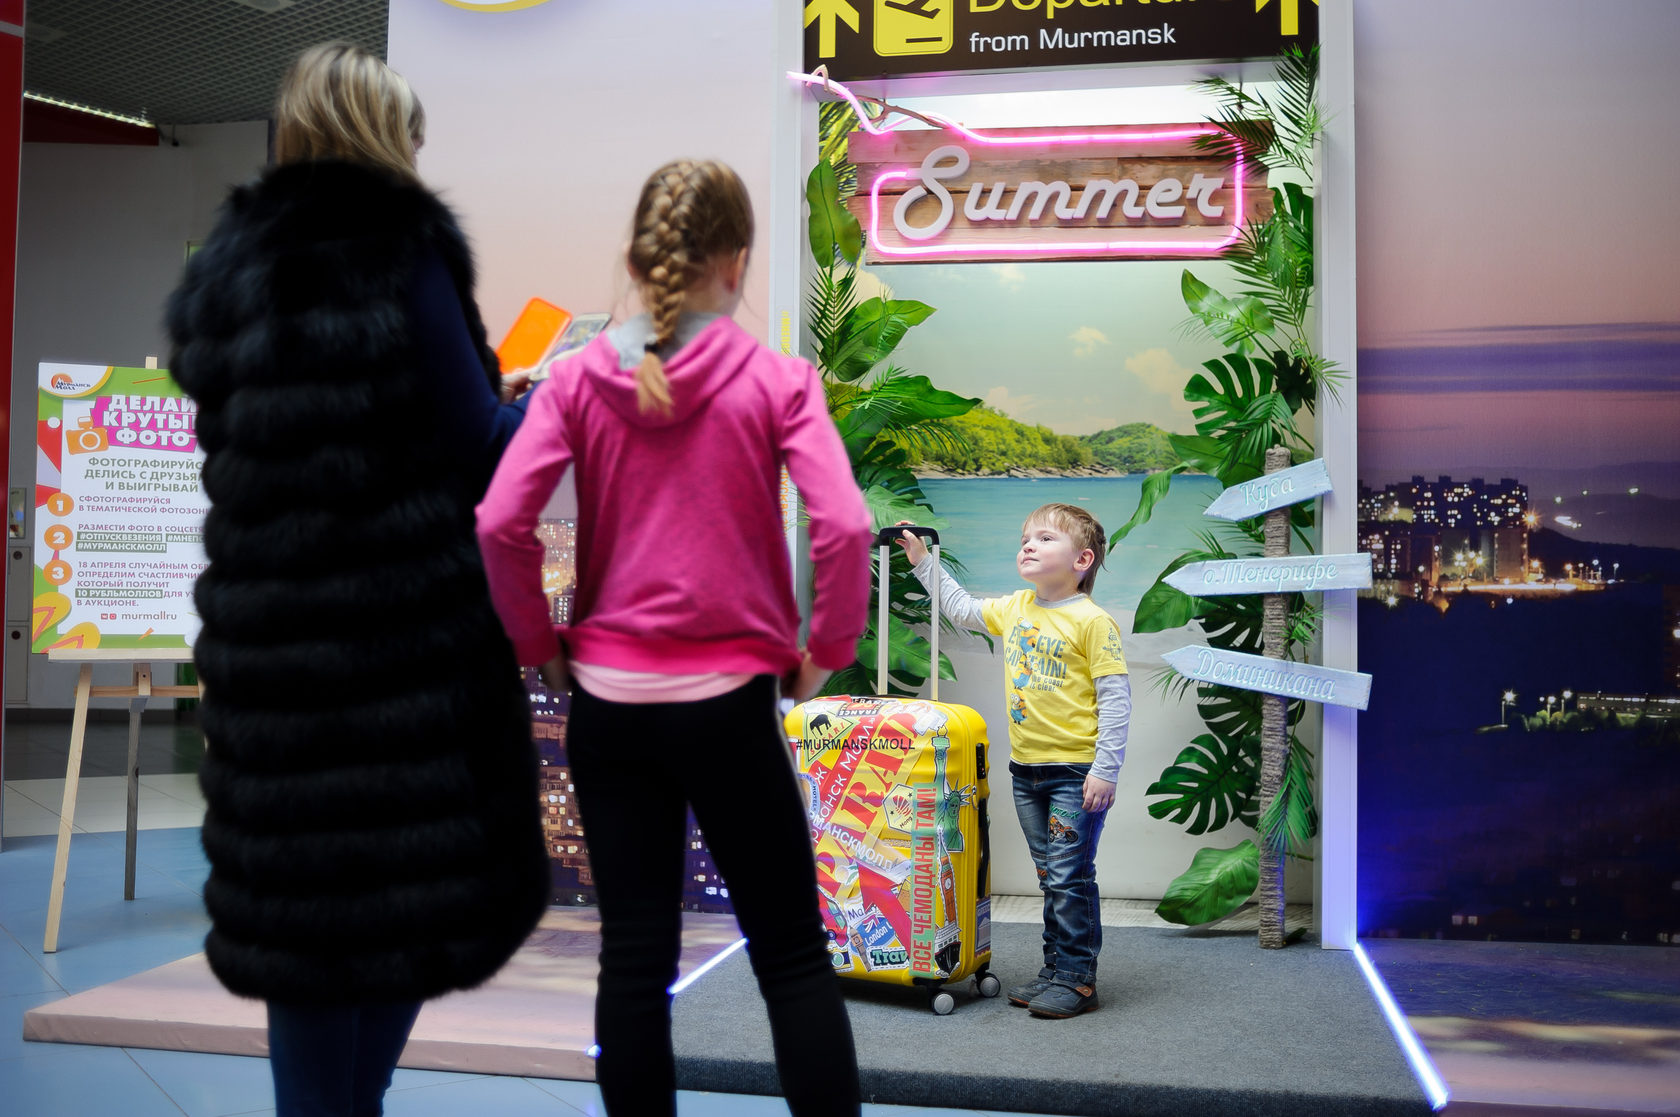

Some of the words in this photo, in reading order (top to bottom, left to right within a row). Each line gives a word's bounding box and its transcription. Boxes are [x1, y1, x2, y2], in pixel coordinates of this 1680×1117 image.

[969, 32, 1029, 53] from
[1039, 22, 1176, 49] Murmansk
[893, 145, 1226, 240] Summer
[115, 427, 190, 447] ФОТО
[88, 457, 203, 470] ФОТОГРАФИРУЙС
[84, 469, 136, 480] ДЕЛИСЬ
[140, 471, 147, 480] С
[105, 481, 114, 490] И
[118, 481, 198, 493] ВЫИГРЫВАЙ
[1239, 474, 1296, 512] Куба
[56, 500, 64, 512] 1
[79, 495, 171, 505] СФОТОГРАФИРУЙСЯ
[87, 505, 157, 514] ТЕМАТИЧЕСКОЙ
[53, 531, 65, 544] 2
[128, 524, 155, 532] ФОТО
[80, 533, 162, 542] #ОТПУСКВЕЗЕНИЯ
[77, 542, 166, 551] #МУРМАНСКМОЛЛ
[51, 567, 64, 580] 3
[90, 561, 126, 569] АПРЕЛЯ
[128, 561, 188, 570] СЛУЧАЙНЫМ
[77, 571, 136, 579] ОПРЕДЕЛИМ
[77, 580, 123, 588] КОТОРЫЙ
[77, 589, 86, 597] 10
[89, 589, 161, 598] РУБЛЬМОЛЛОВ
[163, 591, 183, 599] ДЛЯ
[121, 611, 177, 620] murmallru
[1193, 648, 1336, 700] Доминикана
[796, 738, 915, 751] #MURMANSKMOLL
[915, 788, 936, 830] ТАМ!
[914, 837, 936, 935] ЧЕМОДАНЫ
[865, 926, 888, 946] London
[912, 940, 932, 973] ВСЕ
